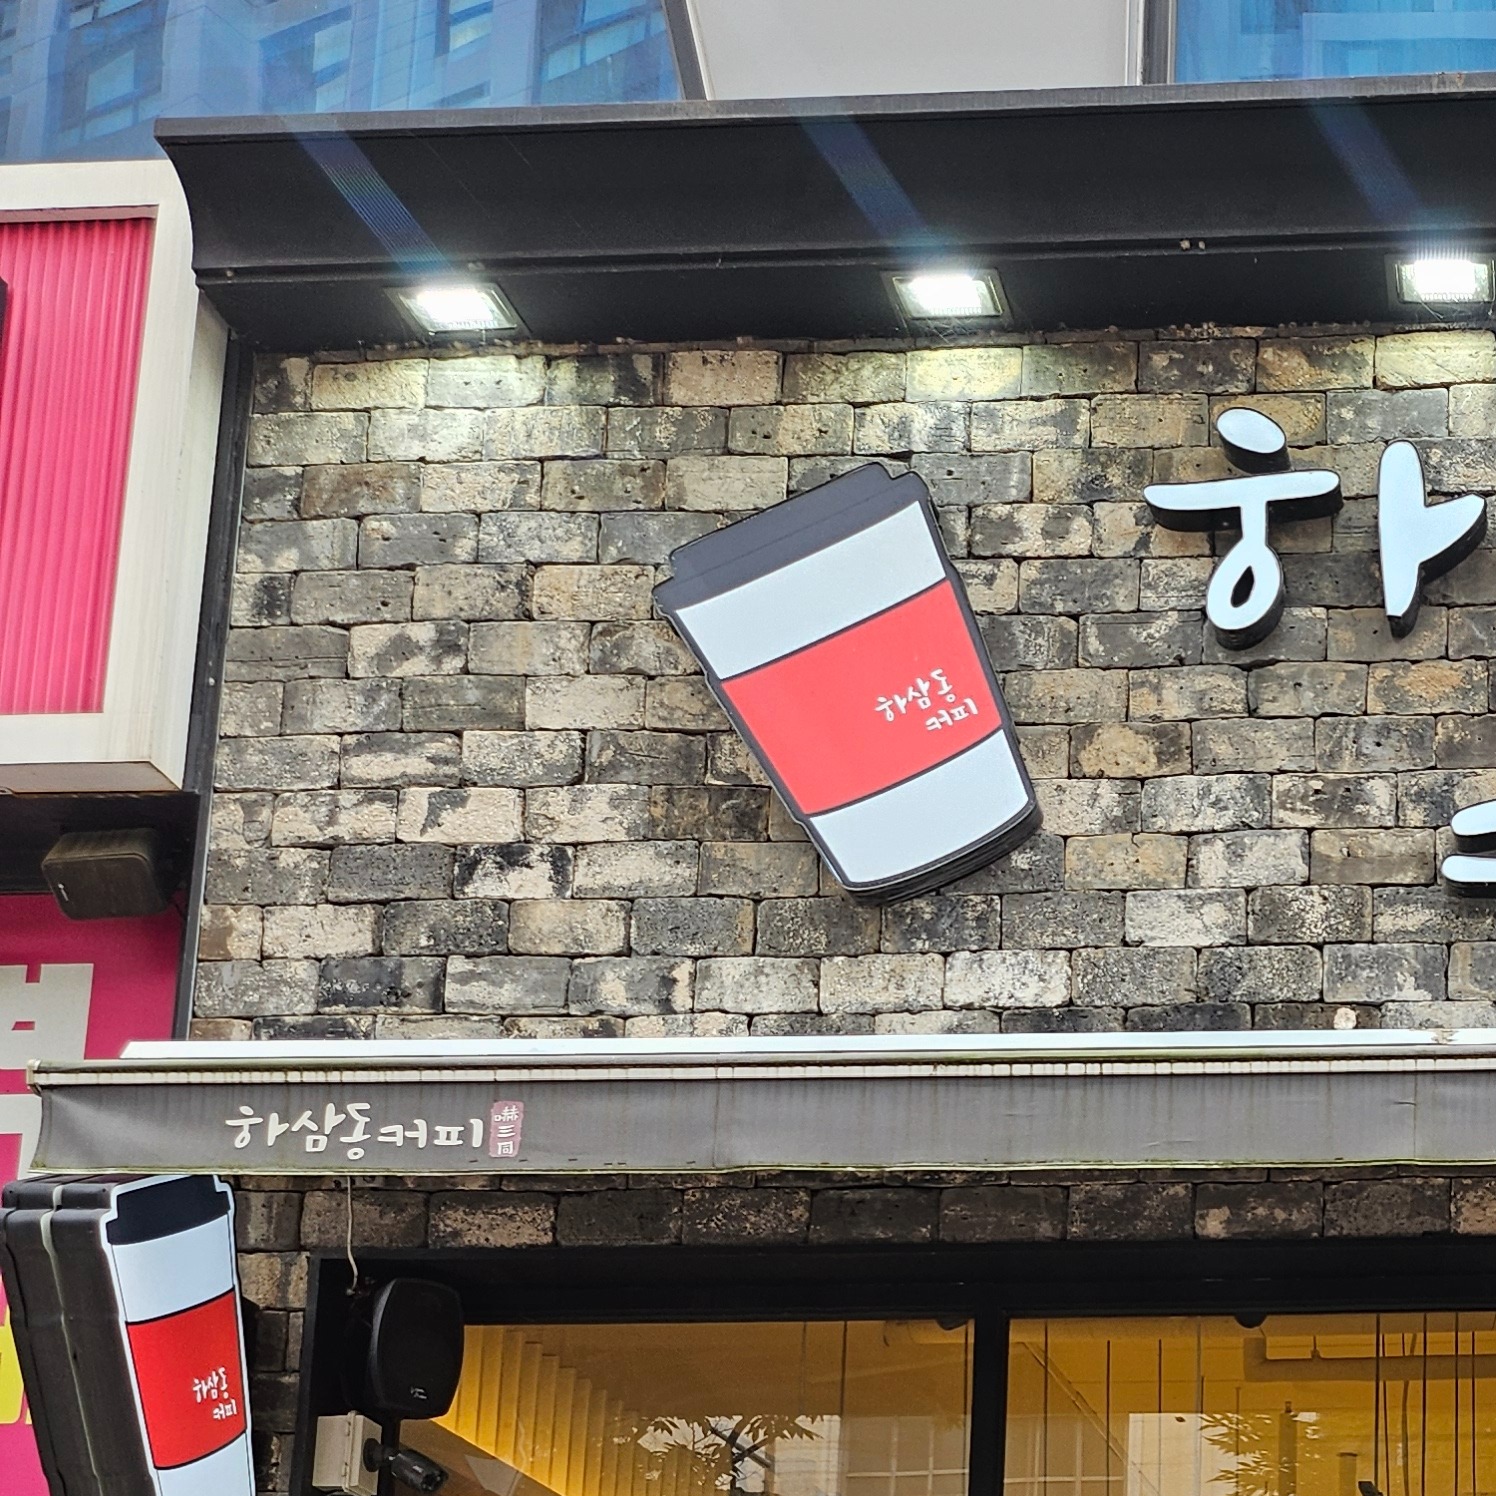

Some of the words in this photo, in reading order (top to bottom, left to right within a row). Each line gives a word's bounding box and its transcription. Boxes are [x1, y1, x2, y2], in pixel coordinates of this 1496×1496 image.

[874, 668, 957, 722] 하삼동
[925, 697, 979, 731] 커피
[225, 1102, 484, 1161] 하삼동커피
[193, 1366, 229, 1402] 하삼동
[212, 1398, 237, 1419] 커피
